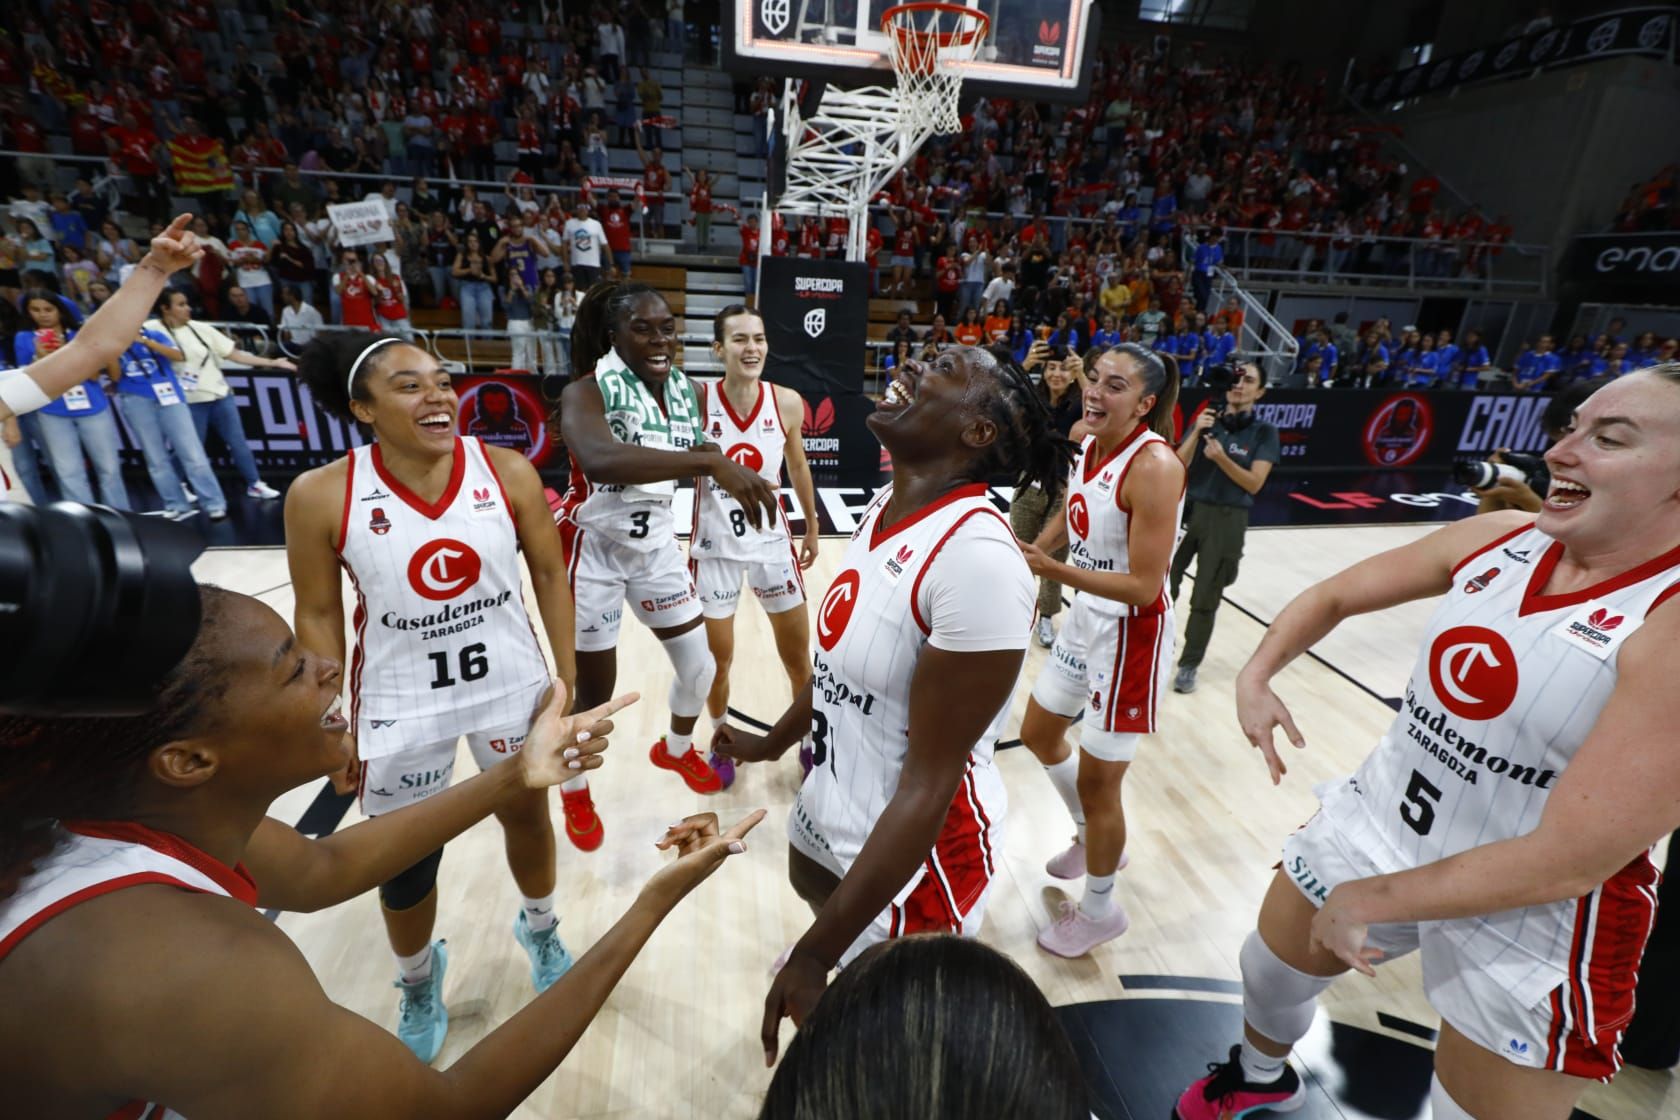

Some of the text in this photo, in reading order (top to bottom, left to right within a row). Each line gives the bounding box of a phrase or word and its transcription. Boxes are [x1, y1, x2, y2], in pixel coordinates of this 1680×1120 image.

[795, 276, 843, 292] SUPERCOPA
[1253, 404, 1317, 428] ERCOPA
[1456, 395, 1552, 451] CAM
[1281, 445, 1306, 456] 025
[629, 510, 651, 539] 3
[729, 508, 746, 537] 8
[421, 614, 485, 640] ZARAGOZA
[428, 642, 489, 690] 16
[1407, 722, 1478, 785] ZARAGOZA
[1400, 768, 1443, 836] 5
